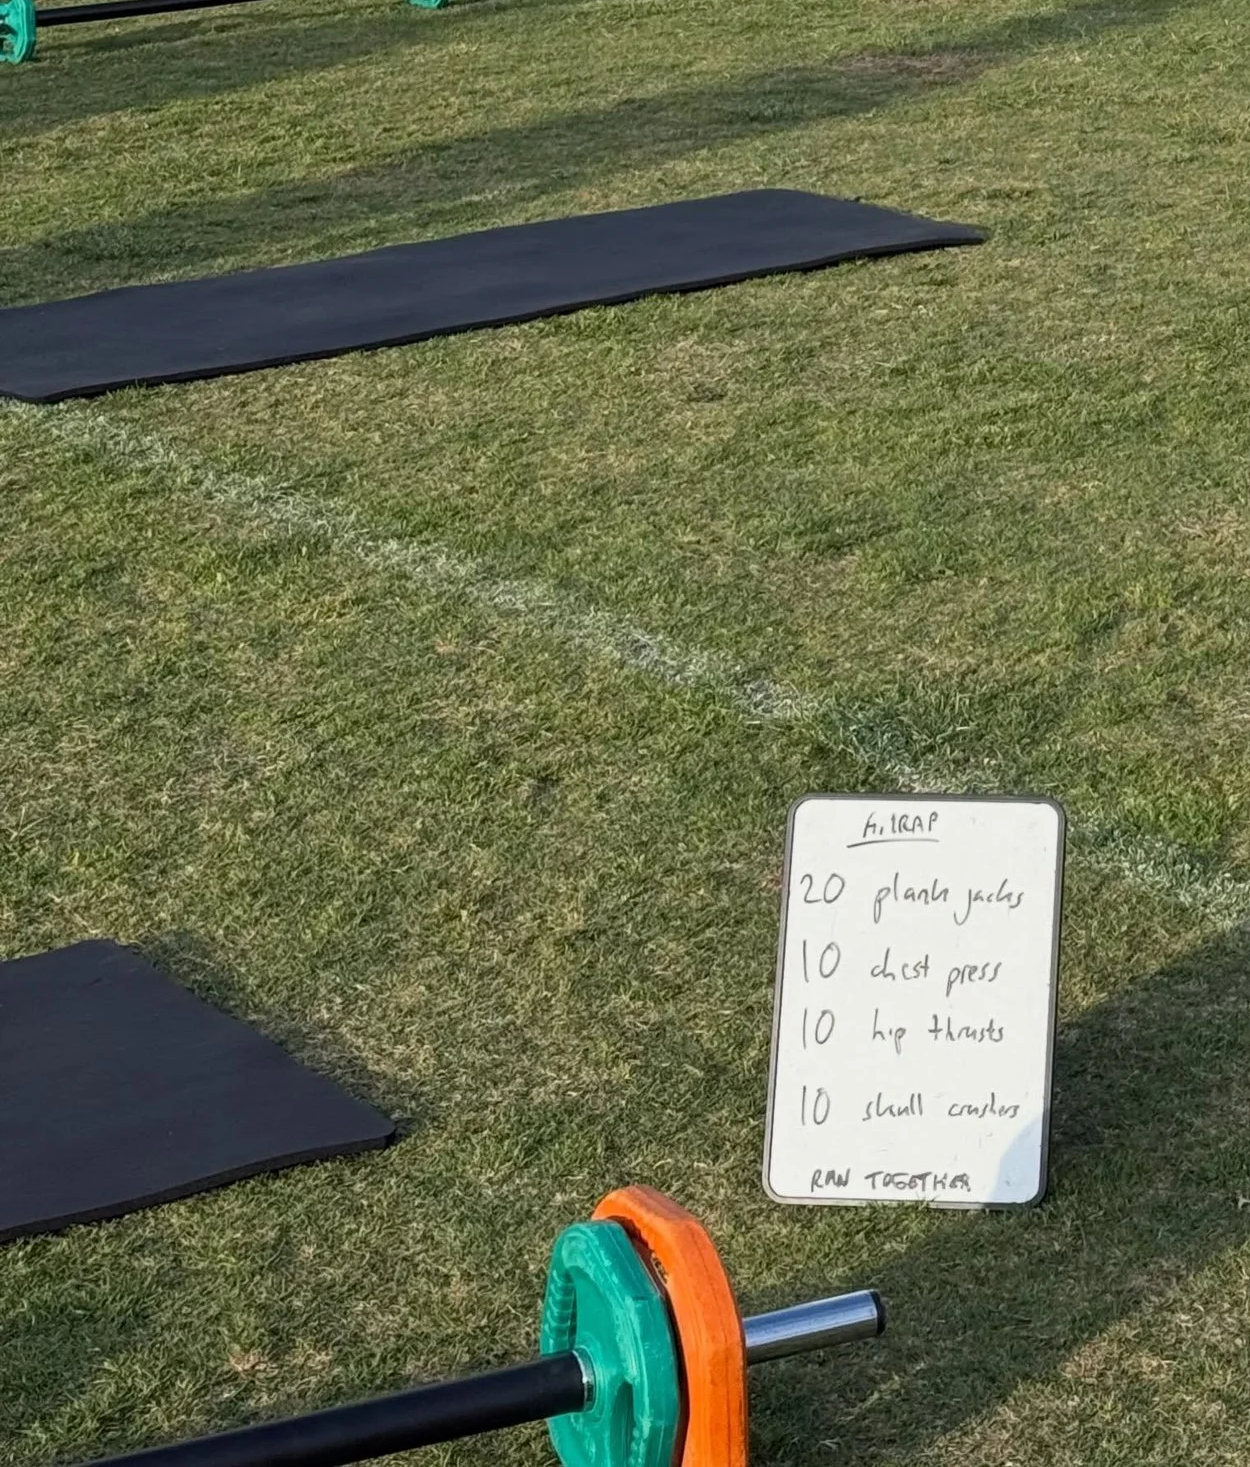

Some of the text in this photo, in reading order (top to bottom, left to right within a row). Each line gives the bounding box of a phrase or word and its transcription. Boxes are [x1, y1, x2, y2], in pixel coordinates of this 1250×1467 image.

[800, 872, 1024, 926] 20 plank jacks
[802, 939, 1001, 997] 10 chest press
[802, 1008, 1004, 1054] 10 hip thrusts
[801, 1085, 830, 1125] 10
[862, 1092, 922, 1121] skull
[864, 1171, 971, 1192] TOGETHER
